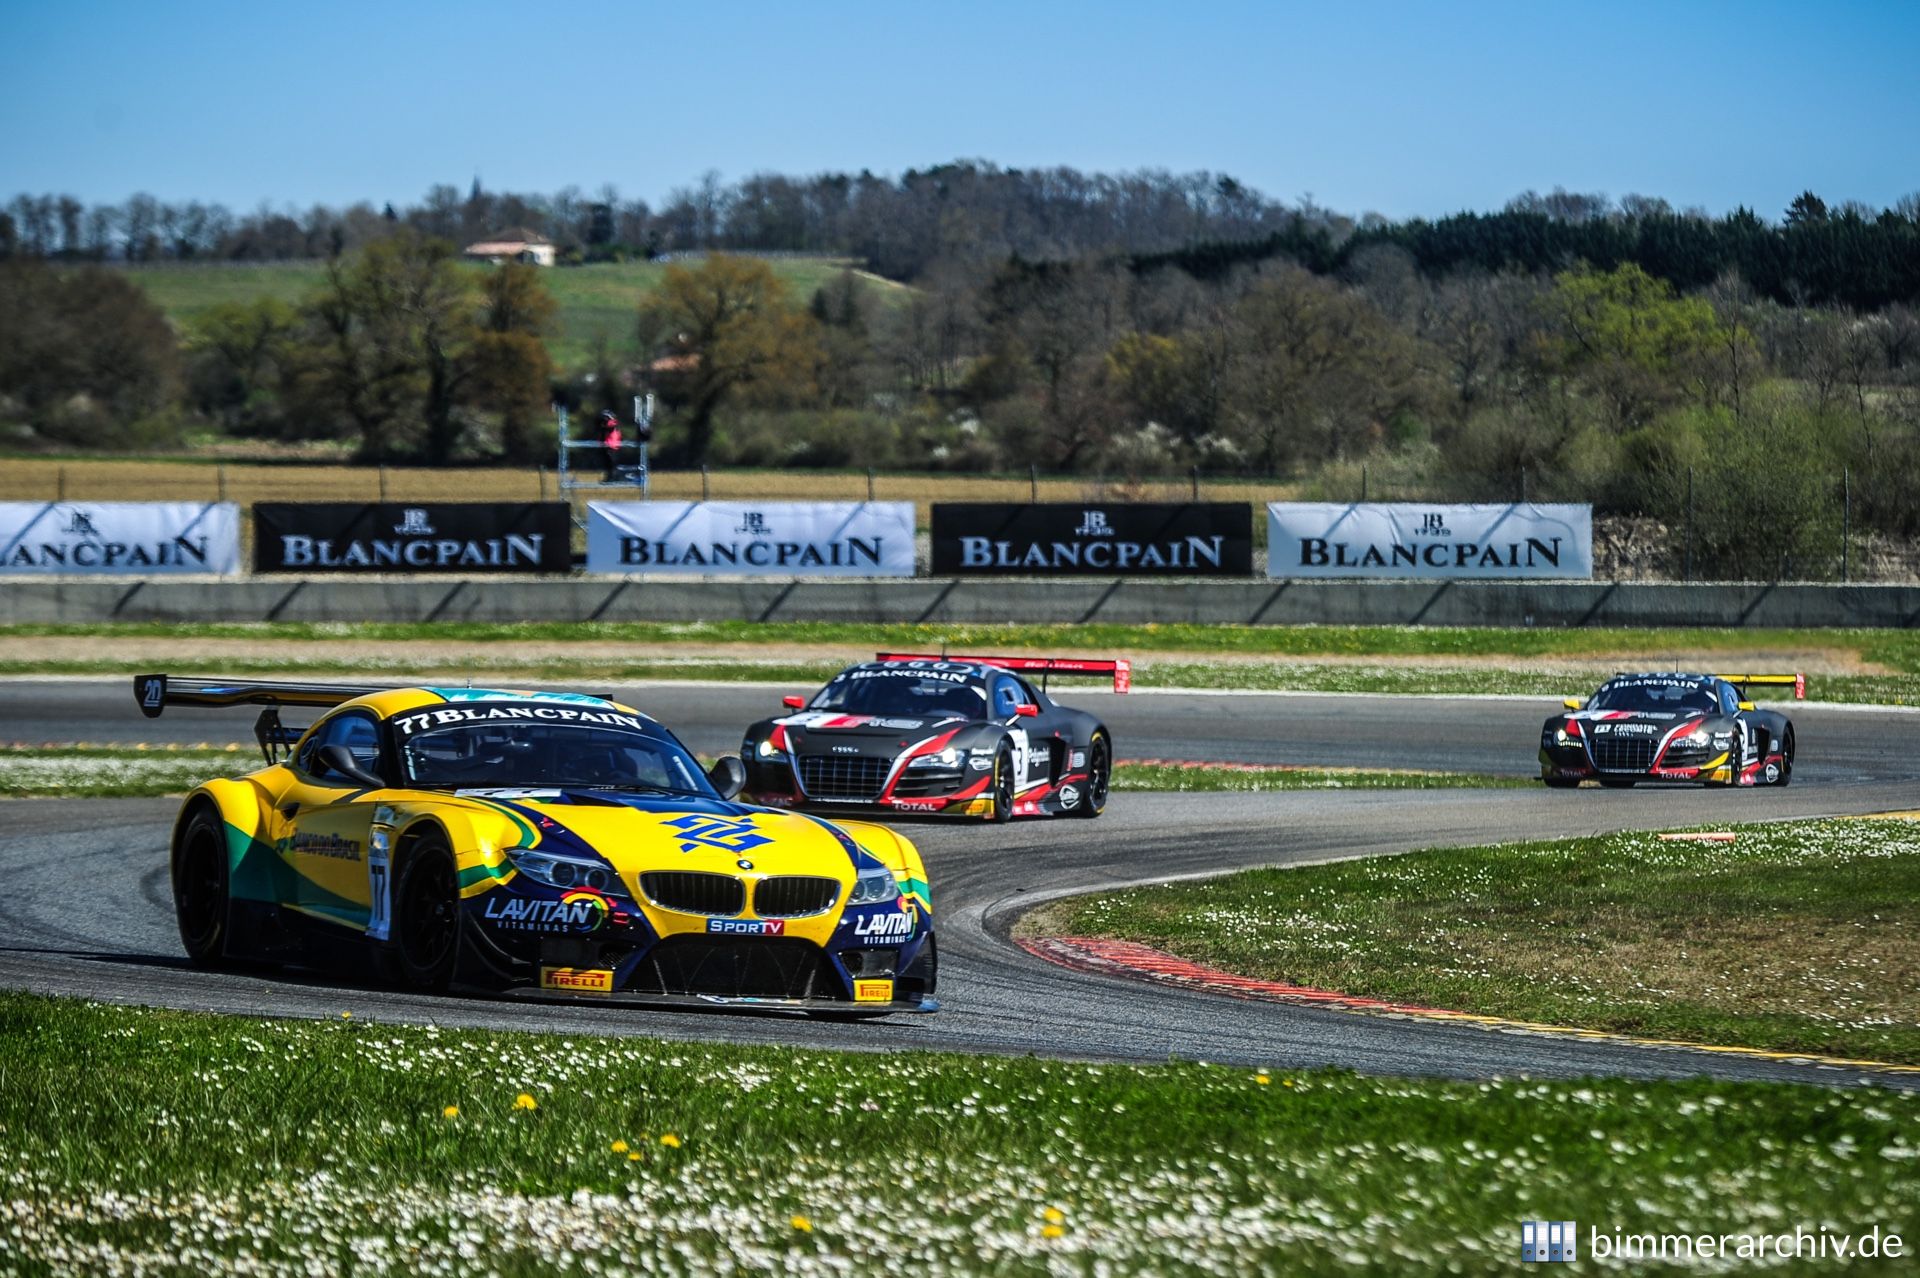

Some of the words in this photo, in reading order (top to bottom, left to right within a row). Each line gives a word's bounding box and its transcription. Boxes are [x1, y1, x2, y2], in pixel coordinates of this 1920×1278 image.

[0, 535, 209, 567] ANCPAIN
[282, 534, 544, 567] BLANCPAIN
[618, 536, 884, 568] BLANCPAIN
[958, 536, 1225, 568] BLANCPAIN
[1297, 537, 1563, 569] BLANCPAIN
[850, 669, 968, 684] BLANCPAIN
[1613, 678, 1700, 690] BLANCPAIN
[393, 715, 431, 735] 77
[431, 707, 643, 731] BLANCPAIN
[1660, 771, 1692, 780] TOTAL
[894, 803, 937, 812] TOTAL
[484, 897, 591, 924] LAVITAN
[497, 920, 569, 933] VITAMINAS
[854, 912, 914, 936] LAVITAN
[863, 935, 906, 945] VITAMINAS
[545, 970, 606, 988] PIRELLI
[859, 984, 890, 998] PIRELLI
